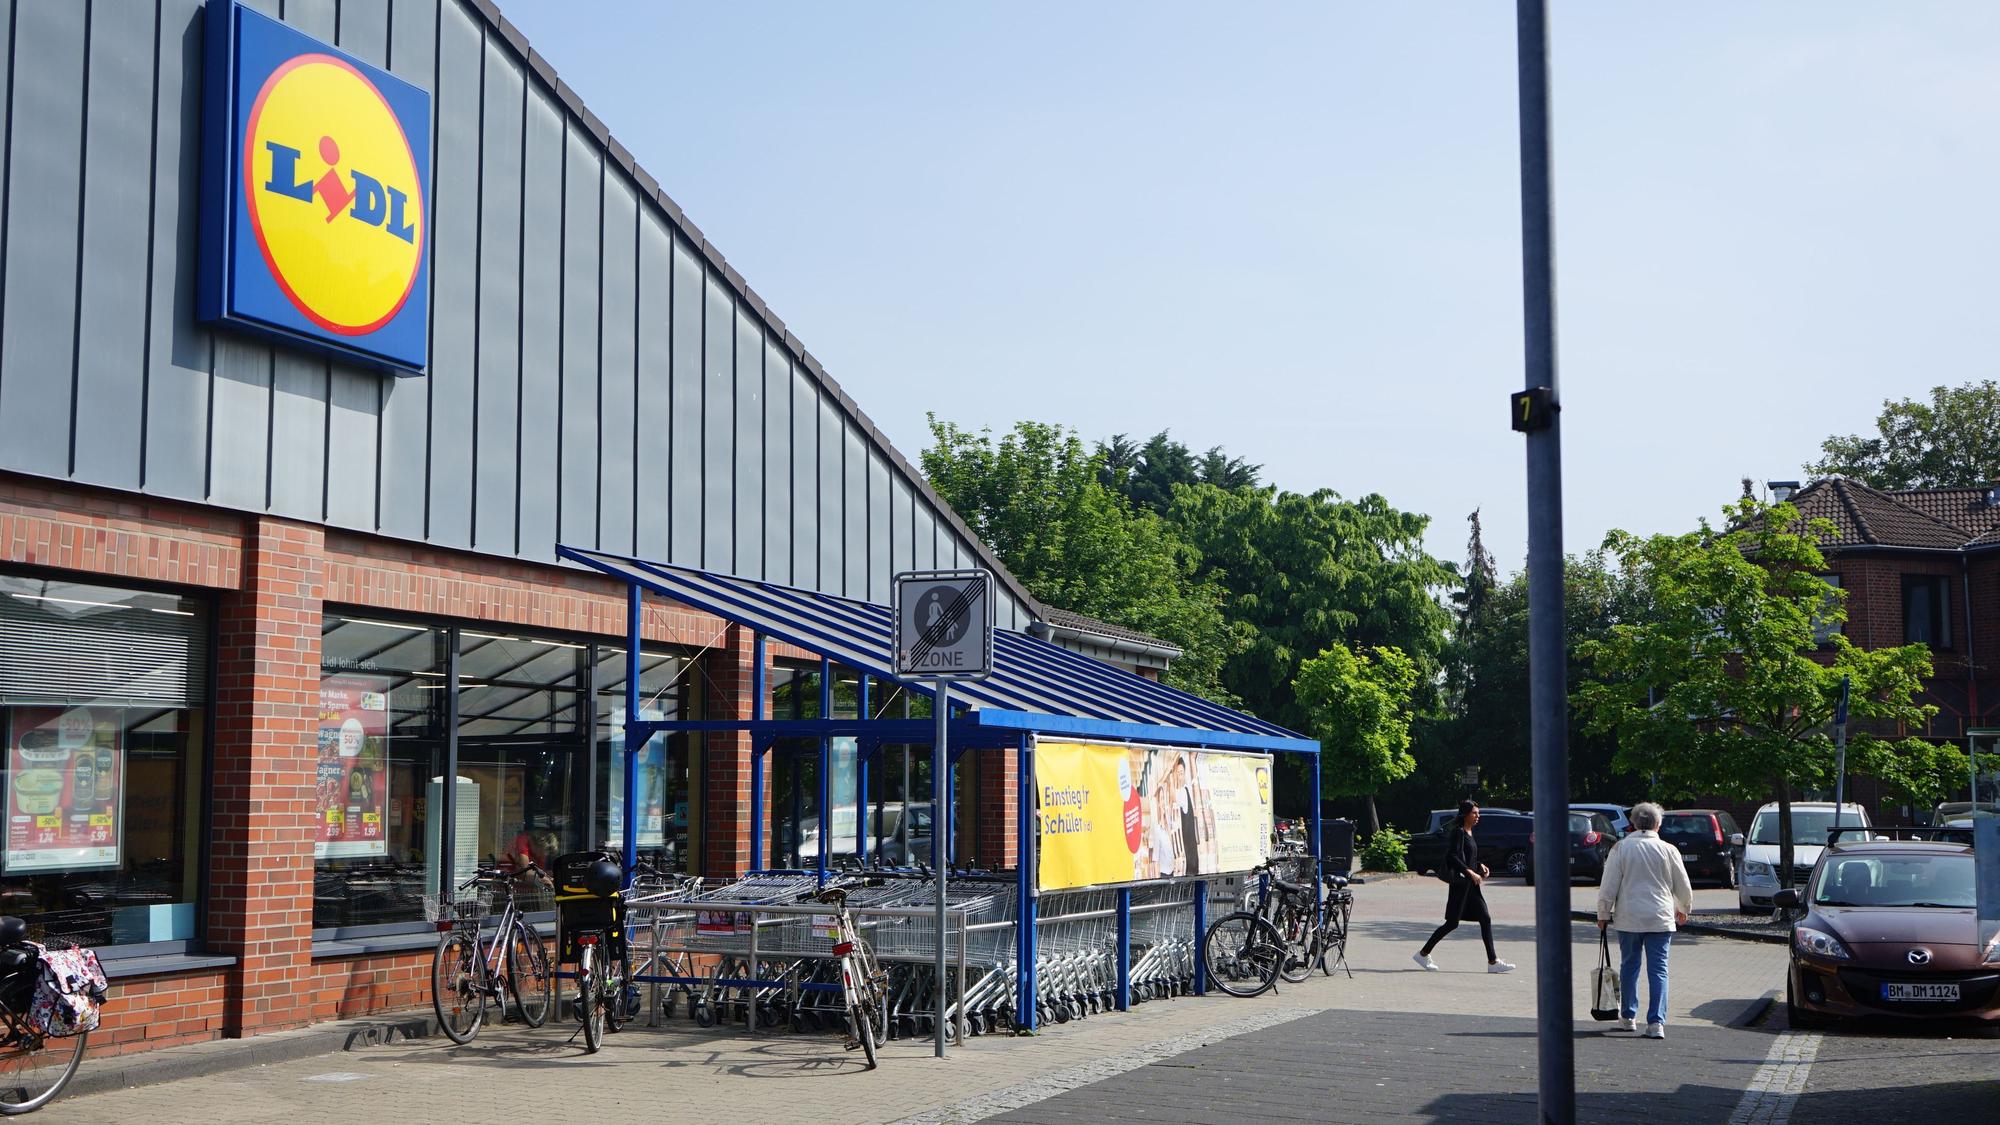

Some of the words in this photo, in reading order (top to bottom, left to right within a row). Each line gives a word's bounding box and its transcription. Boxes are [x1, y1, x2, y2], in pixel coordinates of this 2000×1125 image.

[1520, 396, 1530, 421] 7
[321, 656, 336, 667] Lidl
[339, 657, 359, 669] lohnt
[920, 651, 964, 667] ZONE
[1045, 785, 1082, 810] Einstieg
[1045, 813, 1083, 834] Schüler
[1889, 985, 1904, 997] BM
[1912, 985, 1927, 998] DM
[1929, 985, 1958, 998] 1124
